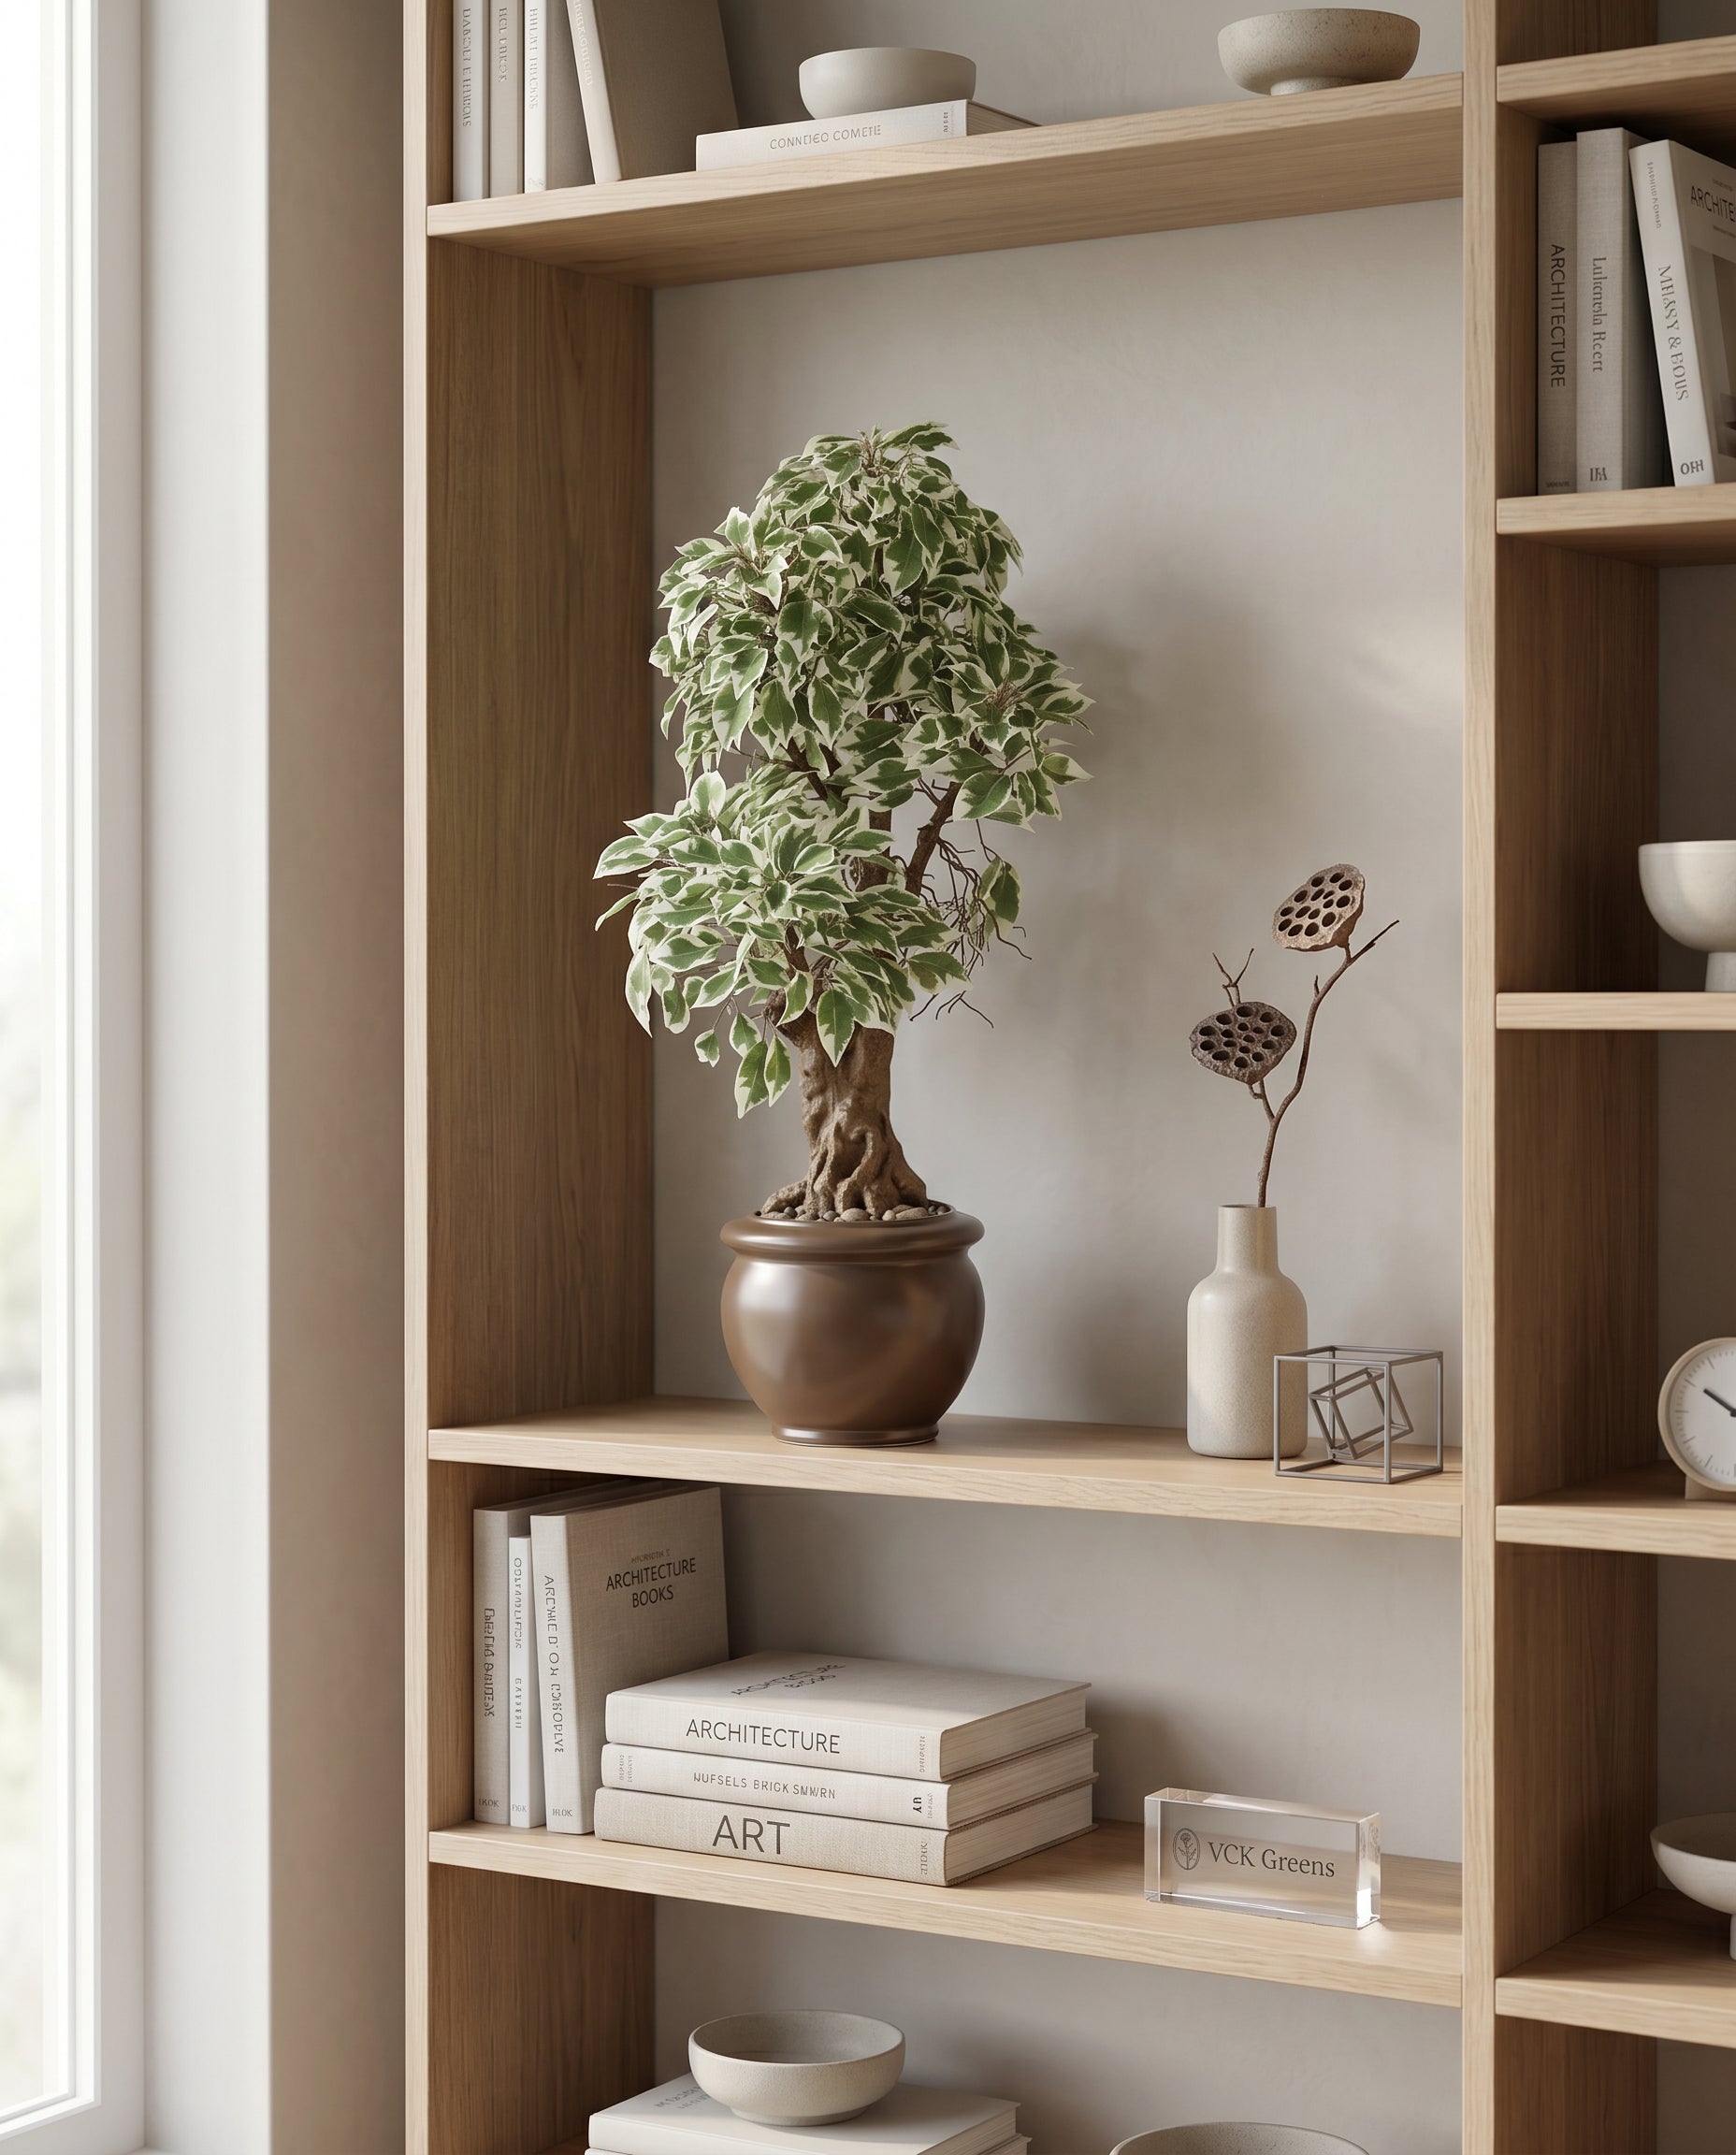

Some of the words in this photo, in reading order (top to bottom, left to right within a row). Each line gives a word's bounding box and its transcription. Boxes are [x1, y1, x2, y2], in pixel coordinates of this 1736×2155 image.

[1691, 185, 1736, 223] ARCHITE
[1550, 243, 1566, 388] ARCHITECTURE
[606, 1557, 697, 1592] ARCHITECTURE
[632, 1584, 674, 1608] BOOKS
[686, 1718, 840, 1754] ARCHITECTURE
[712, 1815, 790, 1855] ART
[1207, 1841, 1256, 1868] VCK
[1261, 1848, 1335, 1878] Greens
